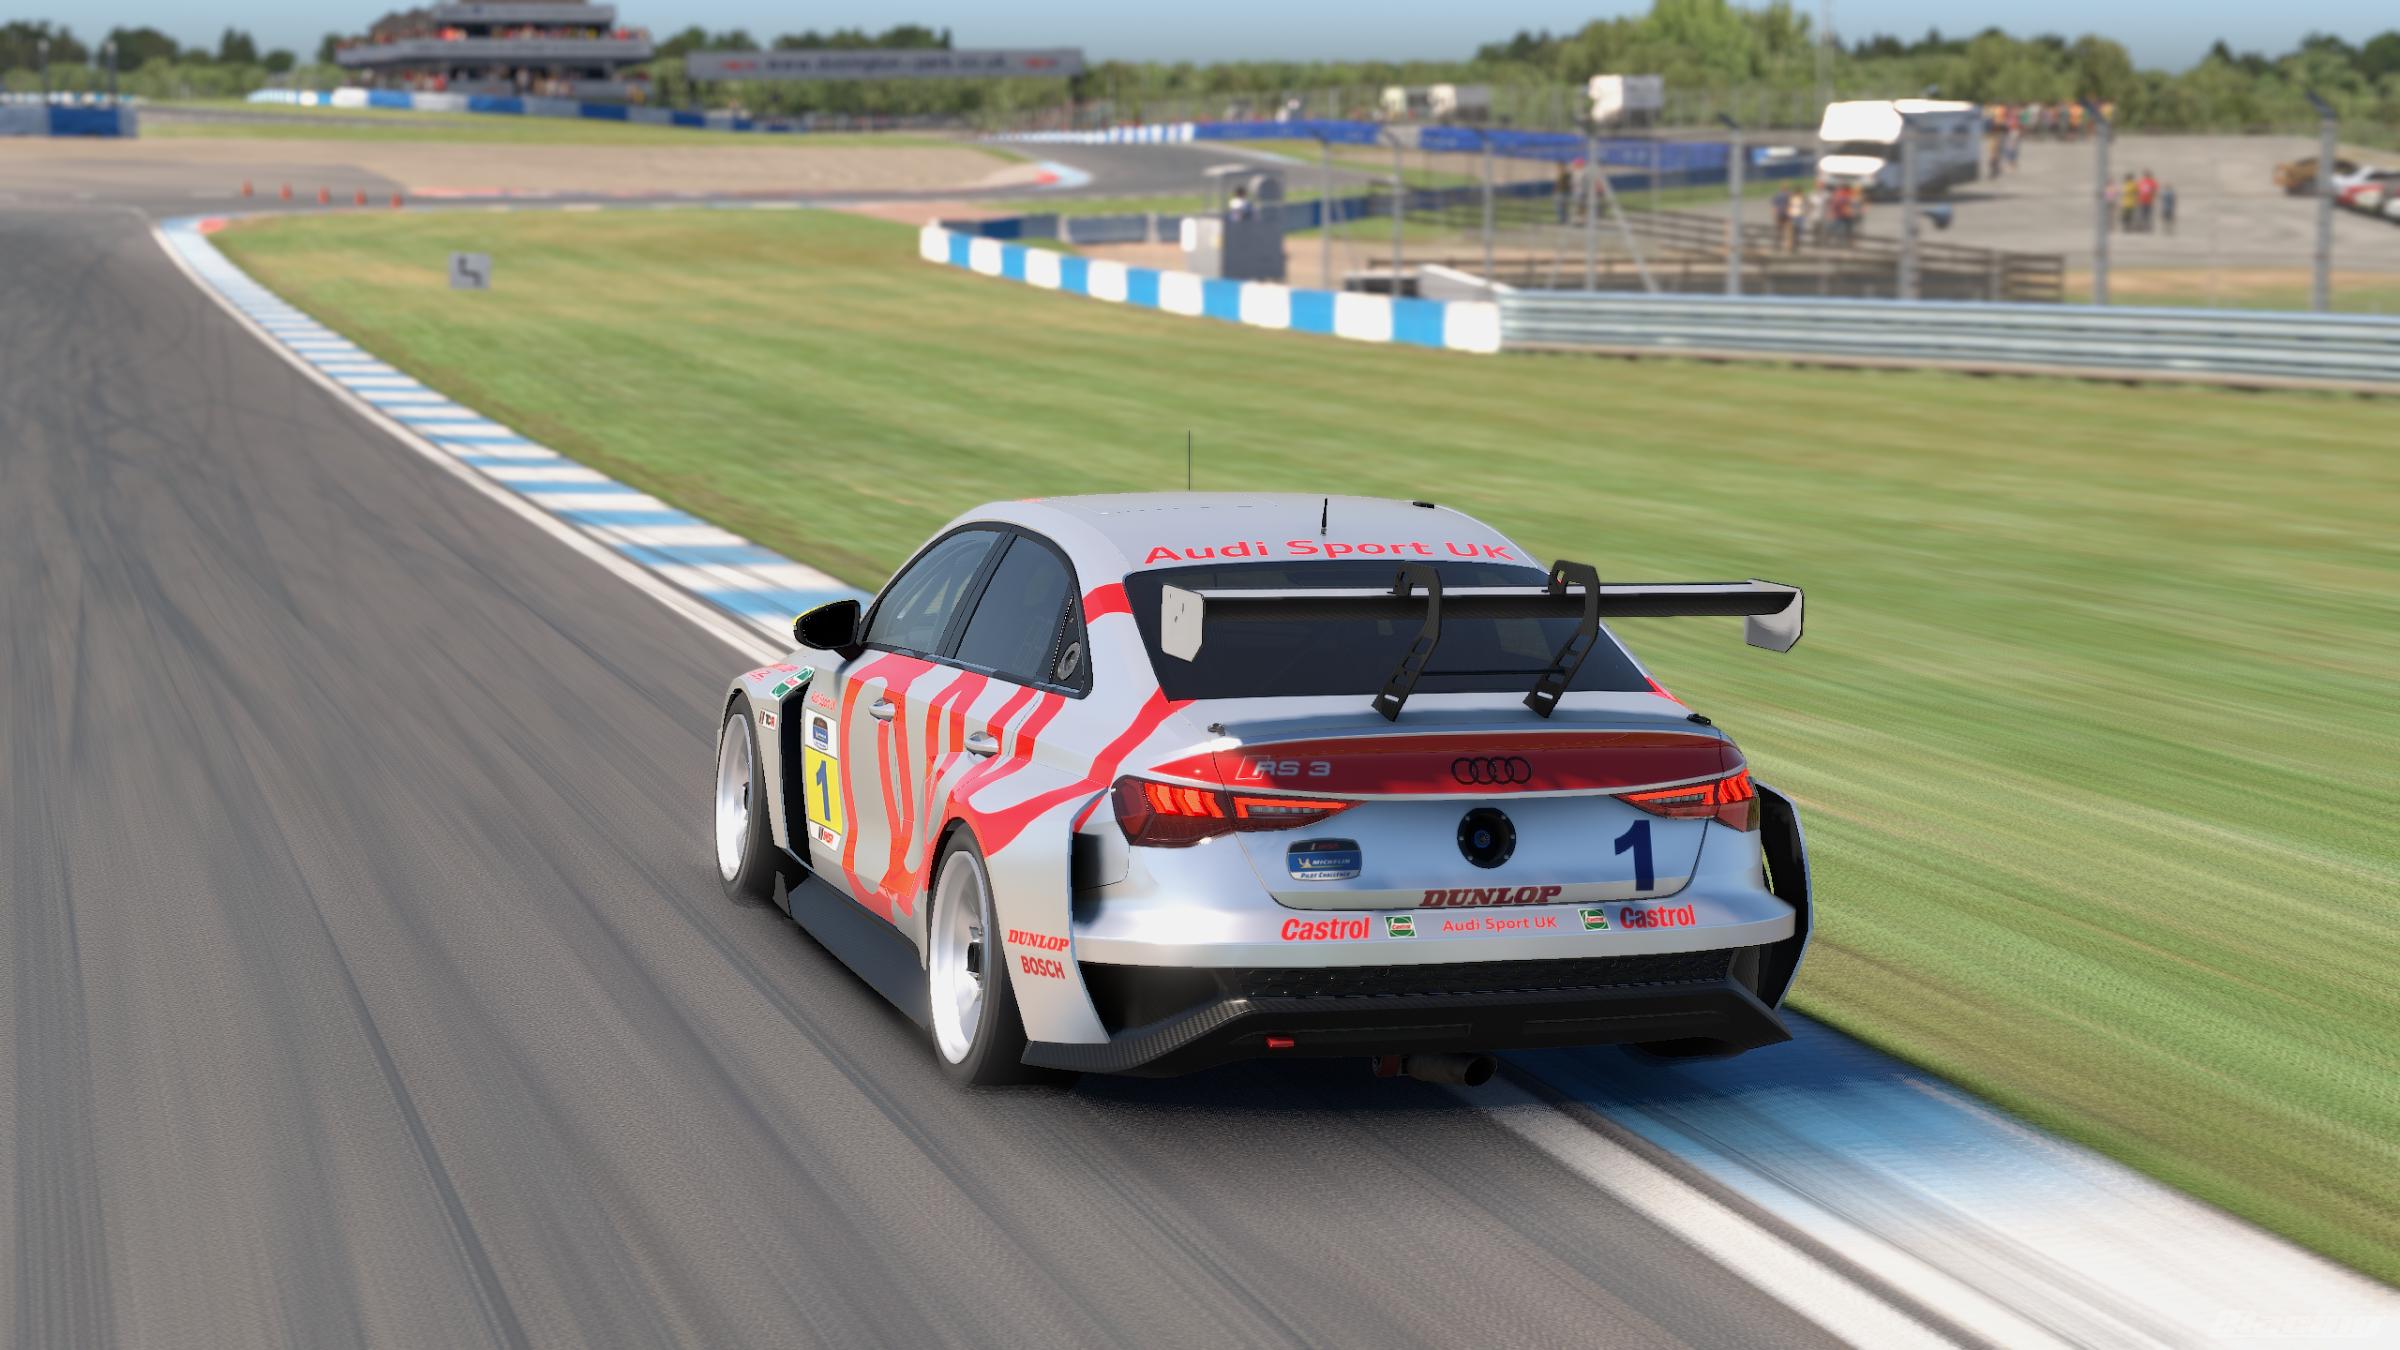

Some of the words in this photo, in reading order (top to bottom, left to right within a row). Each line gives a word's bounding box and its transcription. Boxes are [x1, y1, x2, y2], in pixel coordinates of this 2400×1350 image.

[1144, 541, 1269, 564] Audi
[1286, 540, 1433, 559] Sport
[1446, 541, 1515, 561] UK
[1252, 761, 1300, 776] RS
[1308, 761, 1331, 777] 3
[816, 760, 831, 821] 1
[1614, 819, 1655, 892] 1
[1419, 886, 1562, 907] DUNLOP
[1280, 916, 1371, 941] Castrol
[1442, 918, 1481, 932] Audi
[1485, 917, 1530, 932] Sport
[1533, 915, 1559, 928] UK
[1620, 904, 1697, 929] Castrol
[1007, 929, 1070, 952] DUNLOP
[1020, 955, 1066, 979] BOSCH
